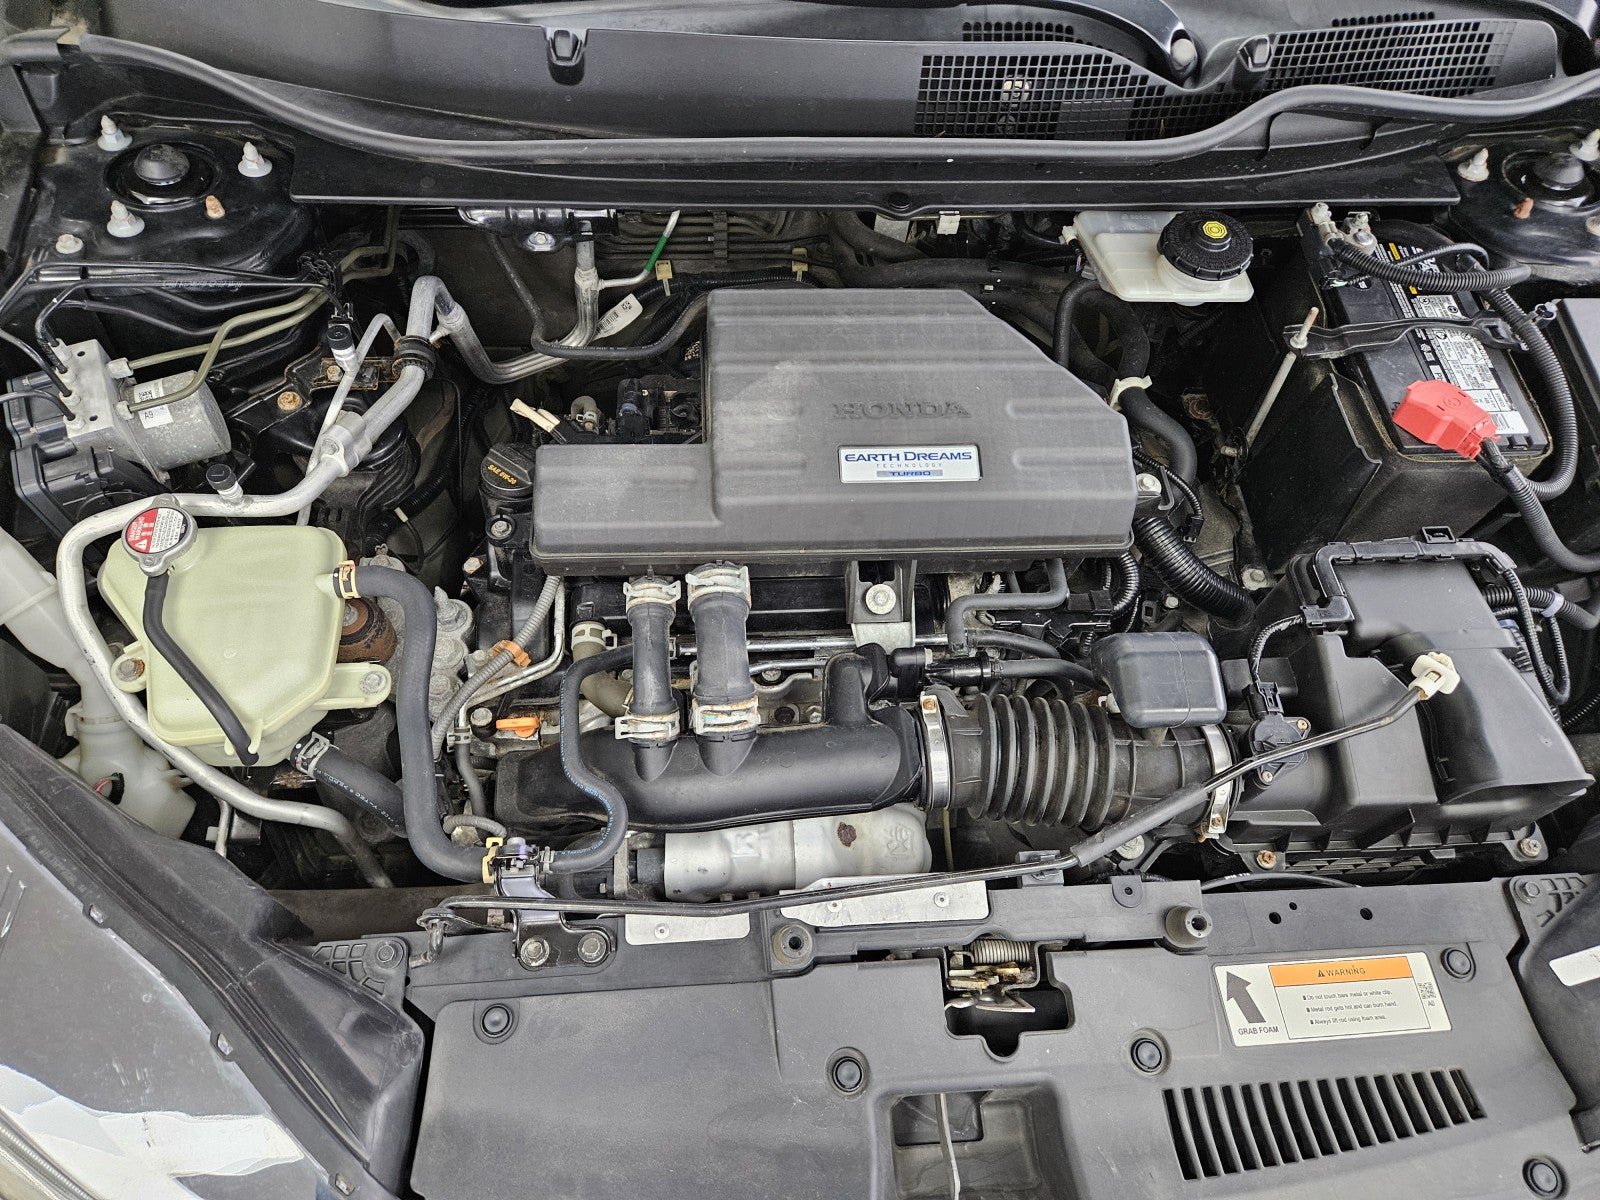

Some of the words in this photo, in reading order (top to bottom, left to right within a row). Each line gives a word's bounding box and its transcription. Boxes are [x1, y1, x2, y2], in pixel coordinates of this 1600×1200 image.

[833, 401, 972, 420] HONDA
[844, 453, 900, 463] EARTH
[904, 451, 973, 461] DREAMS
[488, 464, 501, 475] SAE
[1326, 967, 1366, 977] WARNING
[1314, 1018, 1331, 1026] Always
[1238, 1027, 1258, 1035] GRAB
[1259, 1026, 1280, 1034] FOAM
